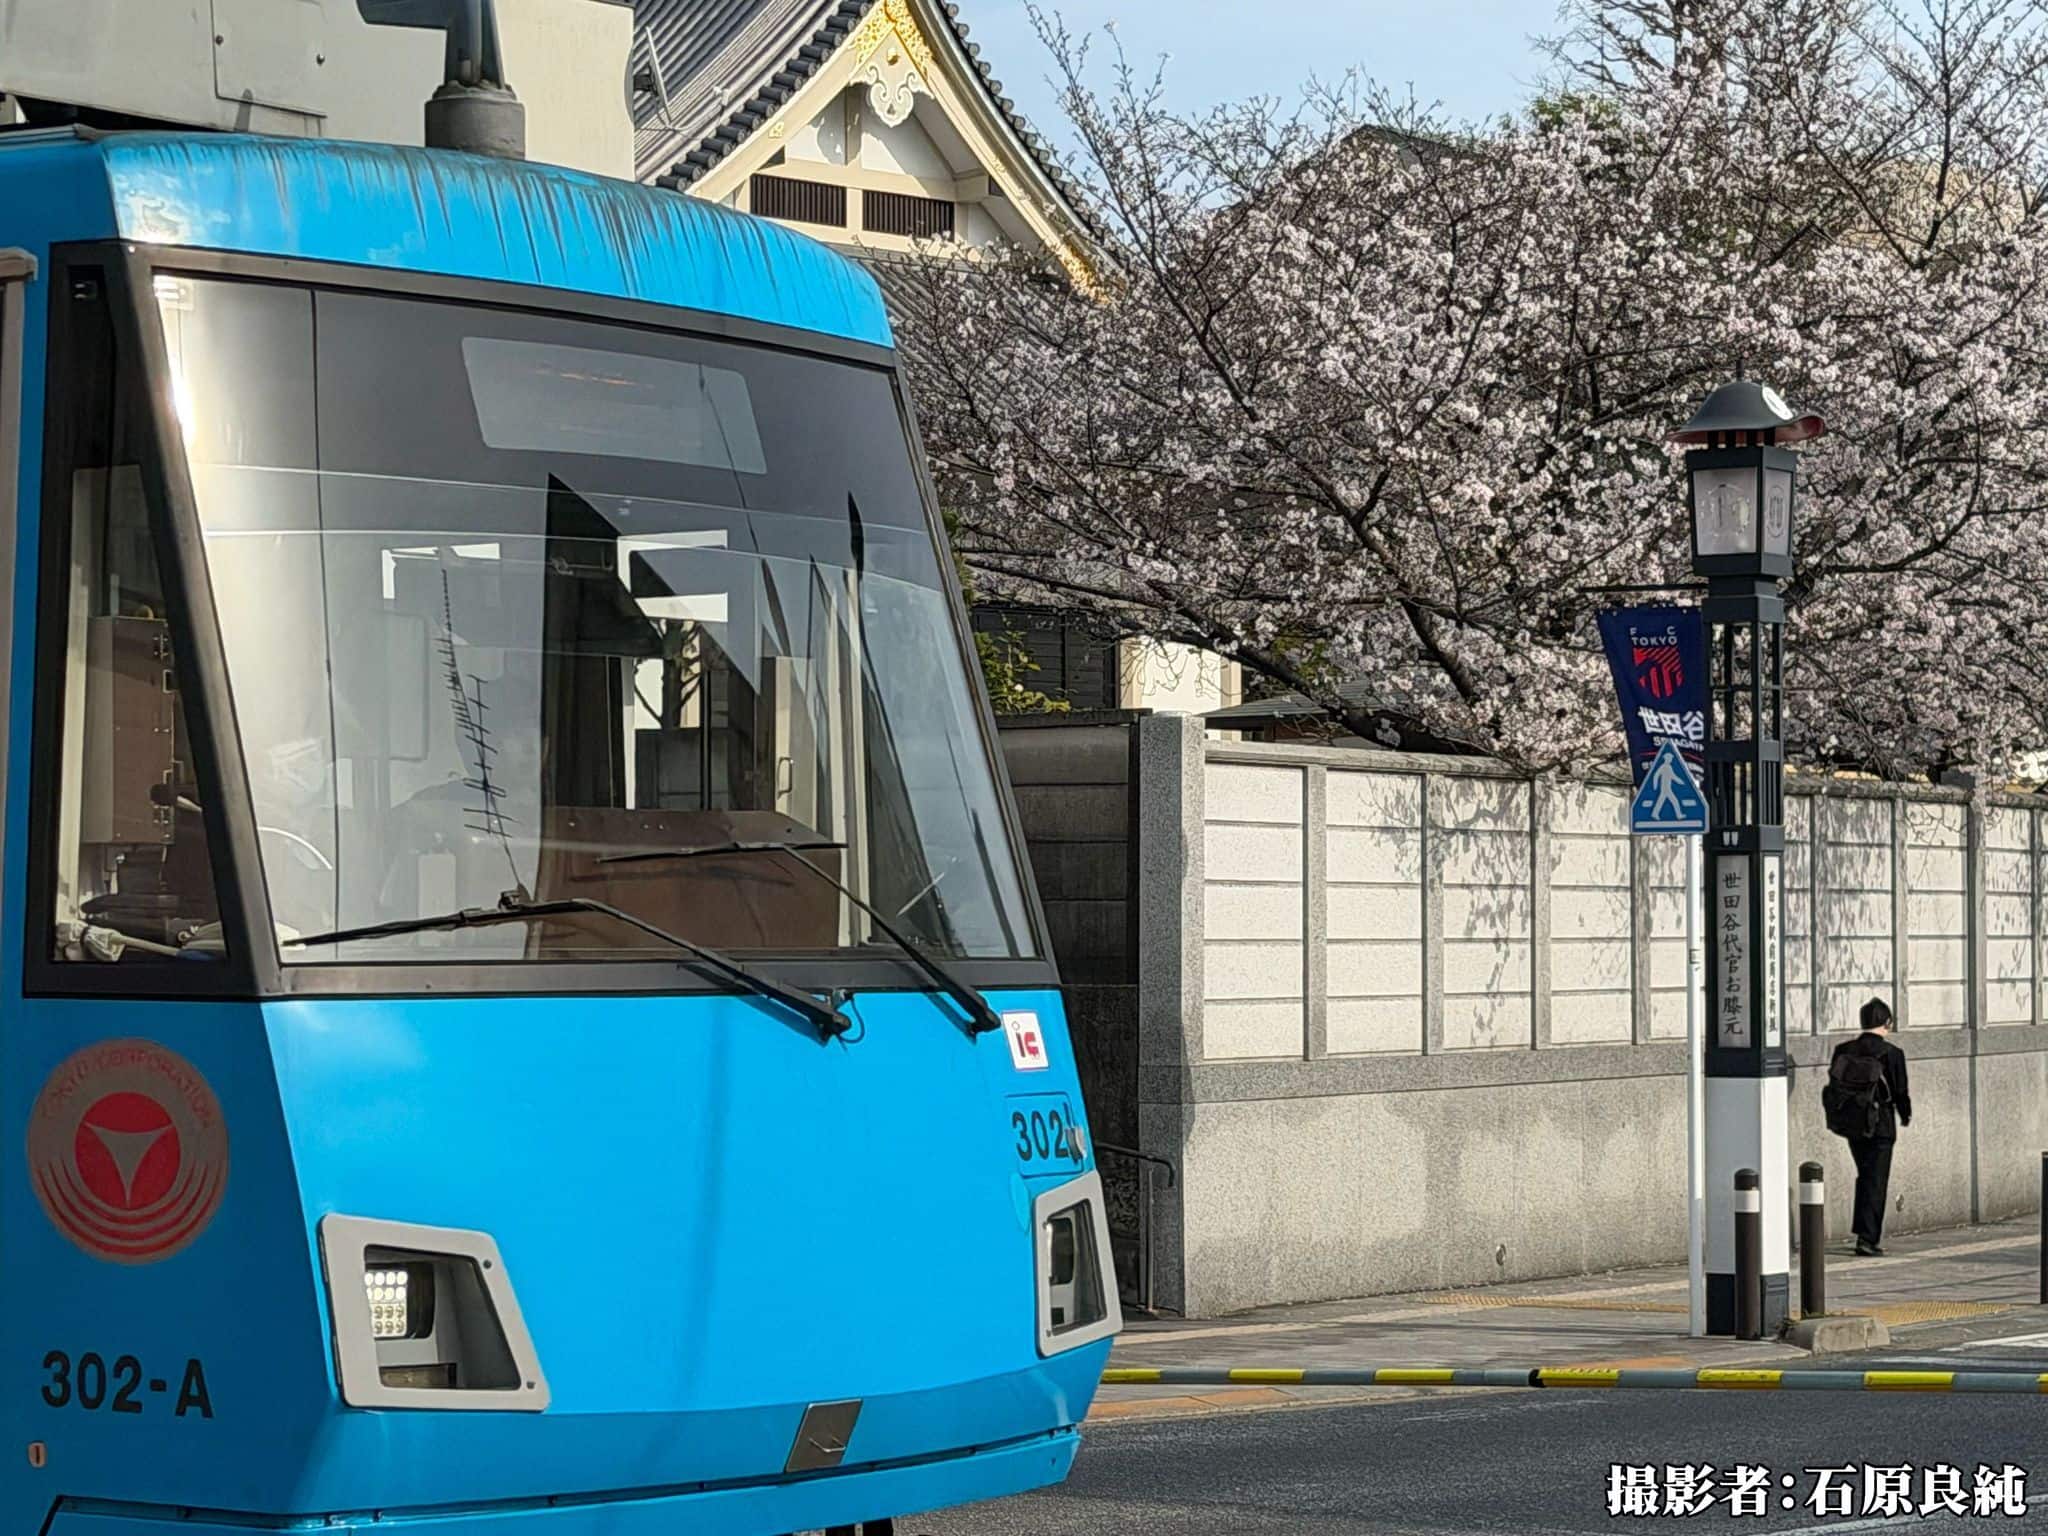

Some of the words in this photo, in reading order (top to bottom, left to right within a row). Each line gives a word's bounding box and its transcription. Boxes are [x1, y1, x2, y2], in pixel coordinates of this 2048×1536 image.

[1631, 636, 1678, 646] TOKYO
[1637, 706, 1704, 740] 世田谷
[1721, 871, 1744, 1035] 世田谷代官お膝元
[1011, 1110, 1070, 1162] 302
[40, 1350, 214, 1419] 302-A
